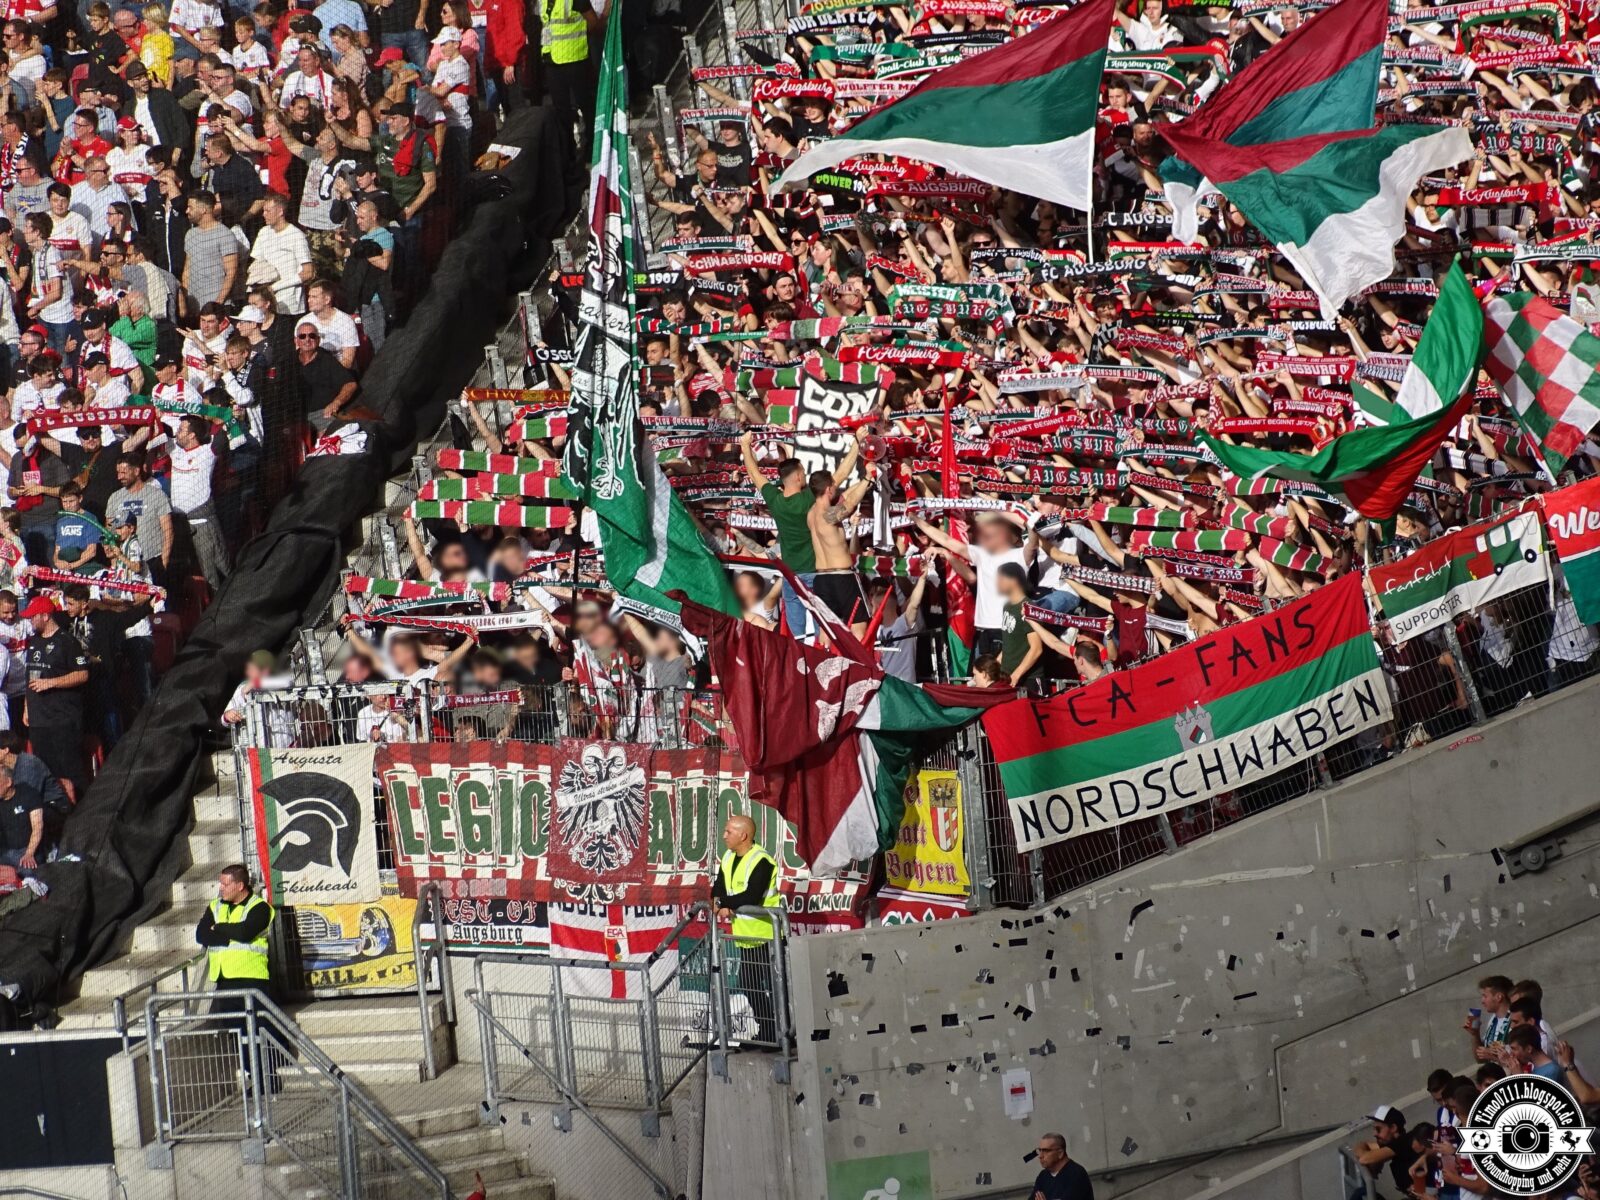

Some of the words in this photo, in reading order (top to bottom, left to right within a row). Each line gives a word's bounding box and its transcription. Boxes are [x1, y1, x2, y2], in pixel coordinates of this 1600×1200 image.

[772, 79, 834, 96] Augsburg
[815, 173, 852, 190] POWER
[909, 182, 987, 195] AUGSBURG
[1041, 267, 1059, 280] FC
[1063, 258, 1148, 278] AUGSBURG
[649, 272, 680, 285] 1907
[896, 283, 957, 300] MEISTER
[881, 347, 941, 363] Augsburg
[803, 377, 878, 420] CON
[62, 408, 153, 424] AUGSBURG
[1238, 418, 1266, 427] ZUKUNFT
[1267, 418, 1295, 426] BEGINNT
[1000, 424, 1034, 438] ZUKUNFT
[1033, 417, 1065, 430] BEGINNT
[977, 479, 1041, 495] ORIGINAL
[1131, 472, 1184, 491] ORIGINAL
[61, 525, 84, 536] VANS
[1395, 594, 1463, 635] SUPPORTER
[1030, 681, 1136, 737] FCA
[1195, 603, 1317, 687] FANS
[454, 692, 510, 706] Augusta
[271, 752, 343, 770] Augusta
[1016, 680, 1381, 843] NORDSCHWABEN
[389, 775, 549, 858] LEGIO
[887, 851, 959, 887] Bayern
[275, 879, 359, 894] Skinheads
[807, 893, 854, 913] MMVII
[452, 924, 524, 944] Augsburg
[309, 967, 361, 987] CALL
